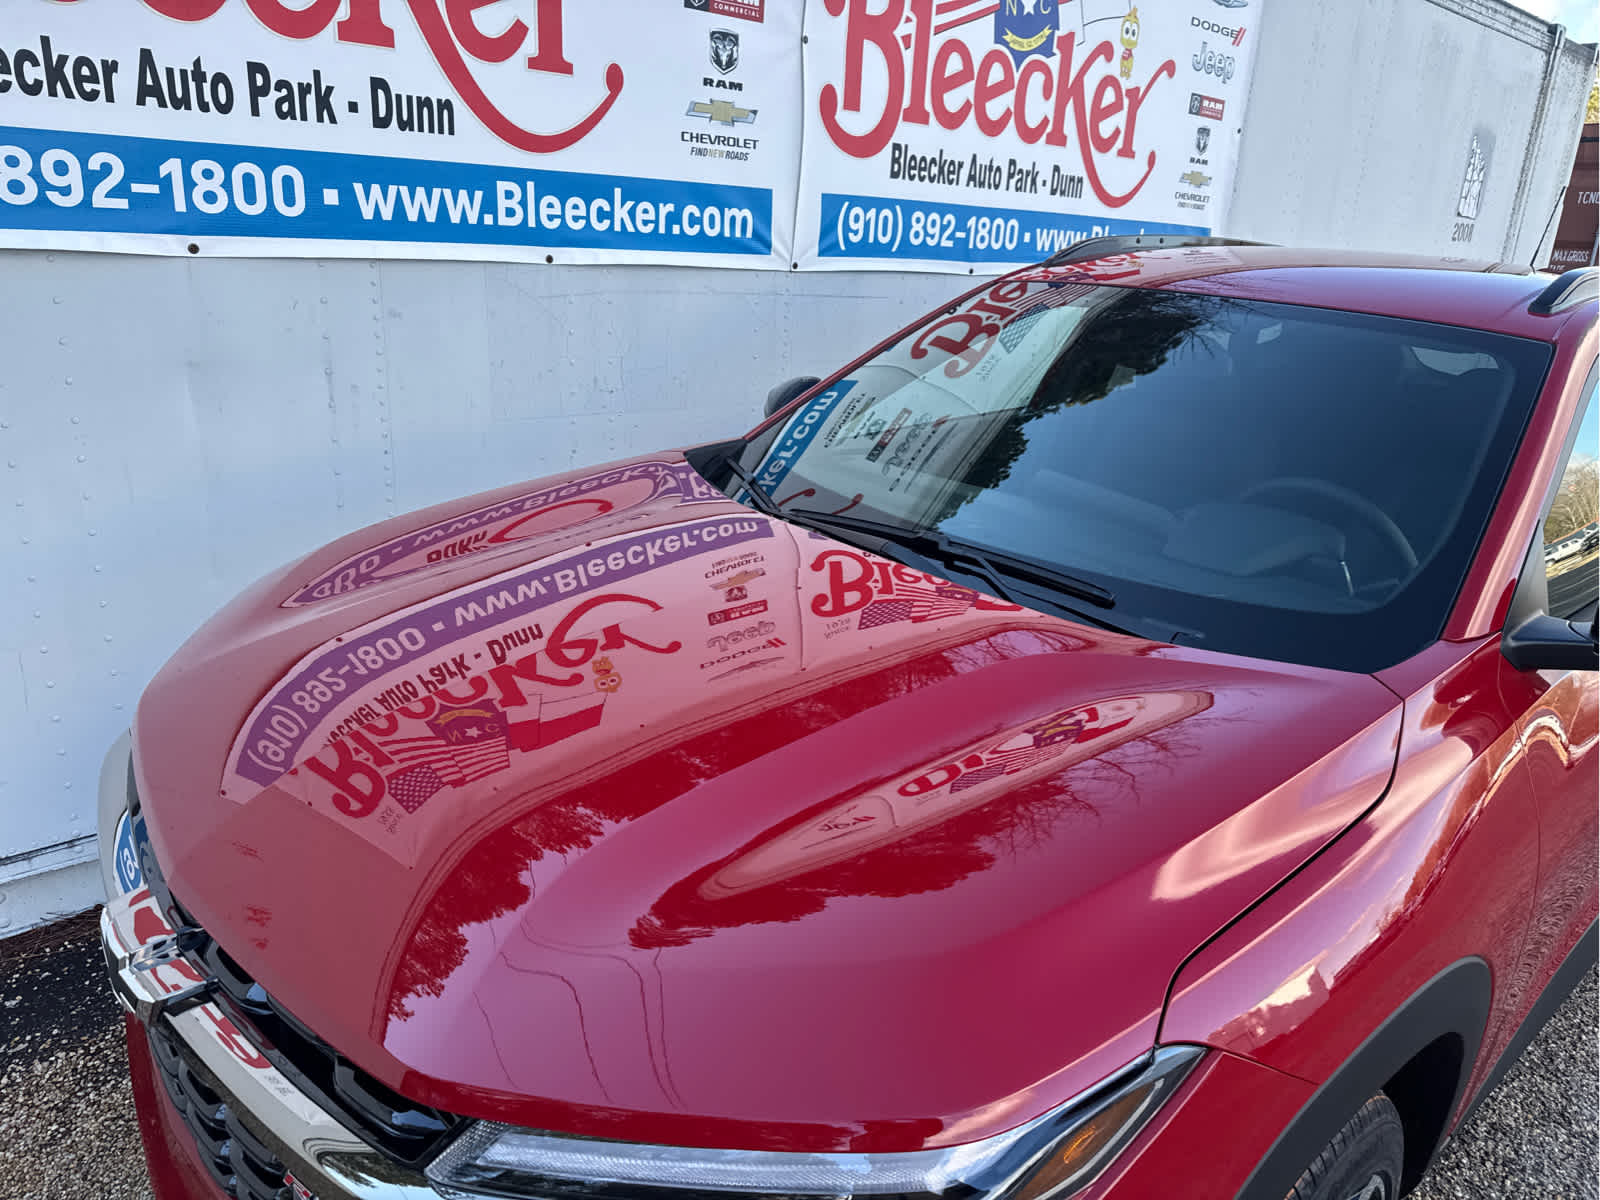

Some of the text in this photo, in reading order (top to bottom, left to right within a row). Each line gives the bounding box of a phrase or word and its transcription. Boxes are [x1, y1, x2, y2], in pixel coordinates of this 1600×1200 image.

[713, 3, 760, 18] COMMERCIAL
[1191, 16, 1239, 39] DODGE
[703, 77, 743, 92] RAM
[1192, 40, 1235, 84] Jeep
[136, 48, 235, 115] Auto
[246, 61, 338, 125] Park
[369, 76, 456, 136] Dunn
[819, 0, 1176, 208] Bleecker
[680, 131, 759, 150] CHEVROLET
[0, 145, 754, 239] 892-1800 www.Bleecker.com
[889, 142, 964, 187] Bleecker
[966, 153, 1001, 191] Auto
[1005, 158, 1039, 194] Park
[1050, 164, 1084, 199] Dunn
[837, 202, 902, 252] (910)
[909, 210, 1020, 251] 892-1800
